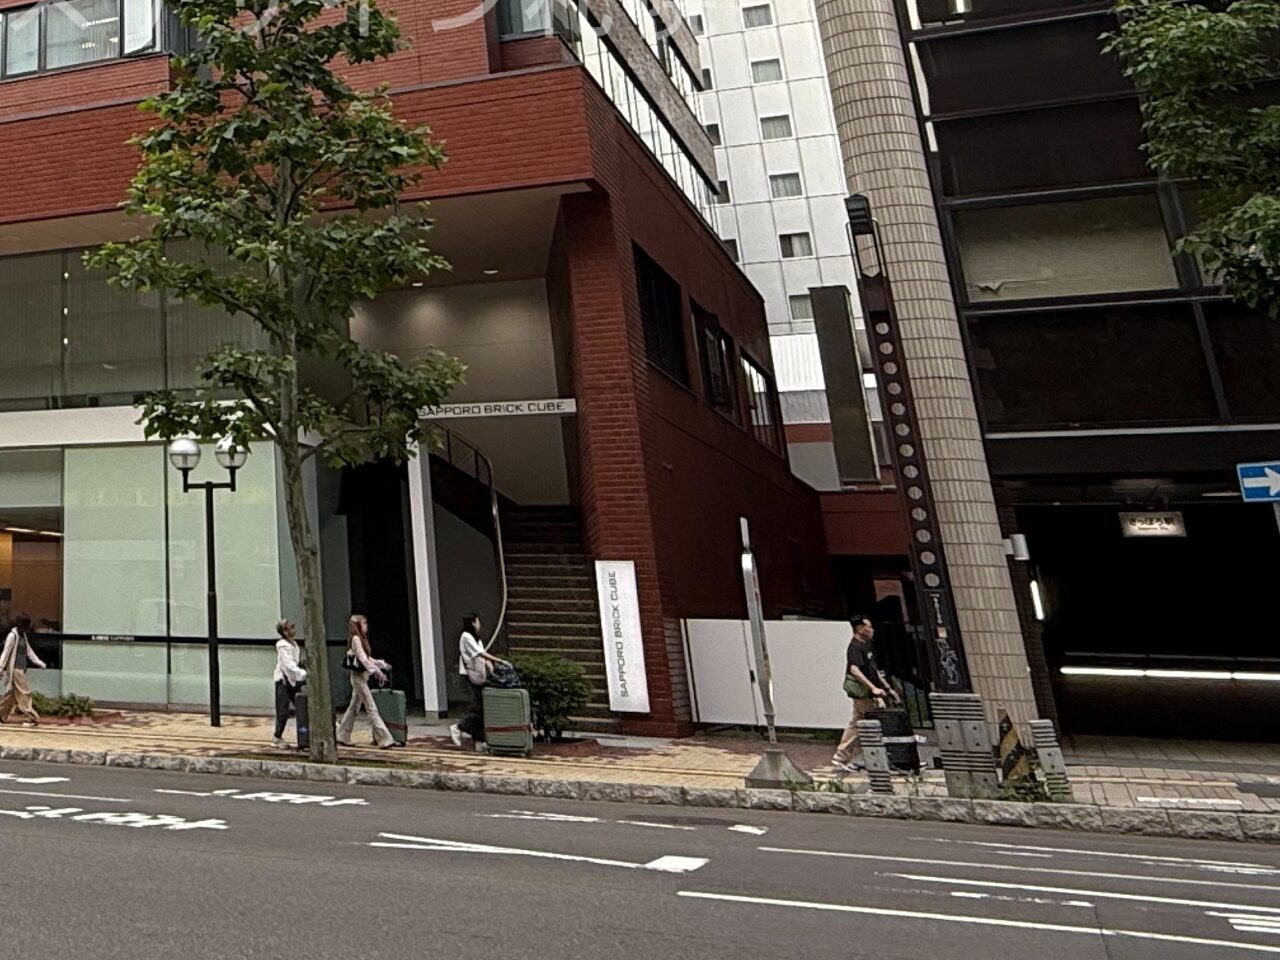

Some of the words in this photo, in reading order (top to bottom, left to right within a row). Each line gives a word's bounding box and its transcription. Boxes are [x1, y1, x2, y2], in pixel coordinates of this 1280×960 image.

[418, 404, 481, 417] SAPPORO
[484, 402, 524, 414] BRICK
[527, 400, 566, 412] CUBE
[608, 570, 618, 601] CUBE
[611, 604, 623, 638] BRICK
[615, 641, 629, 698] SAPPORO
